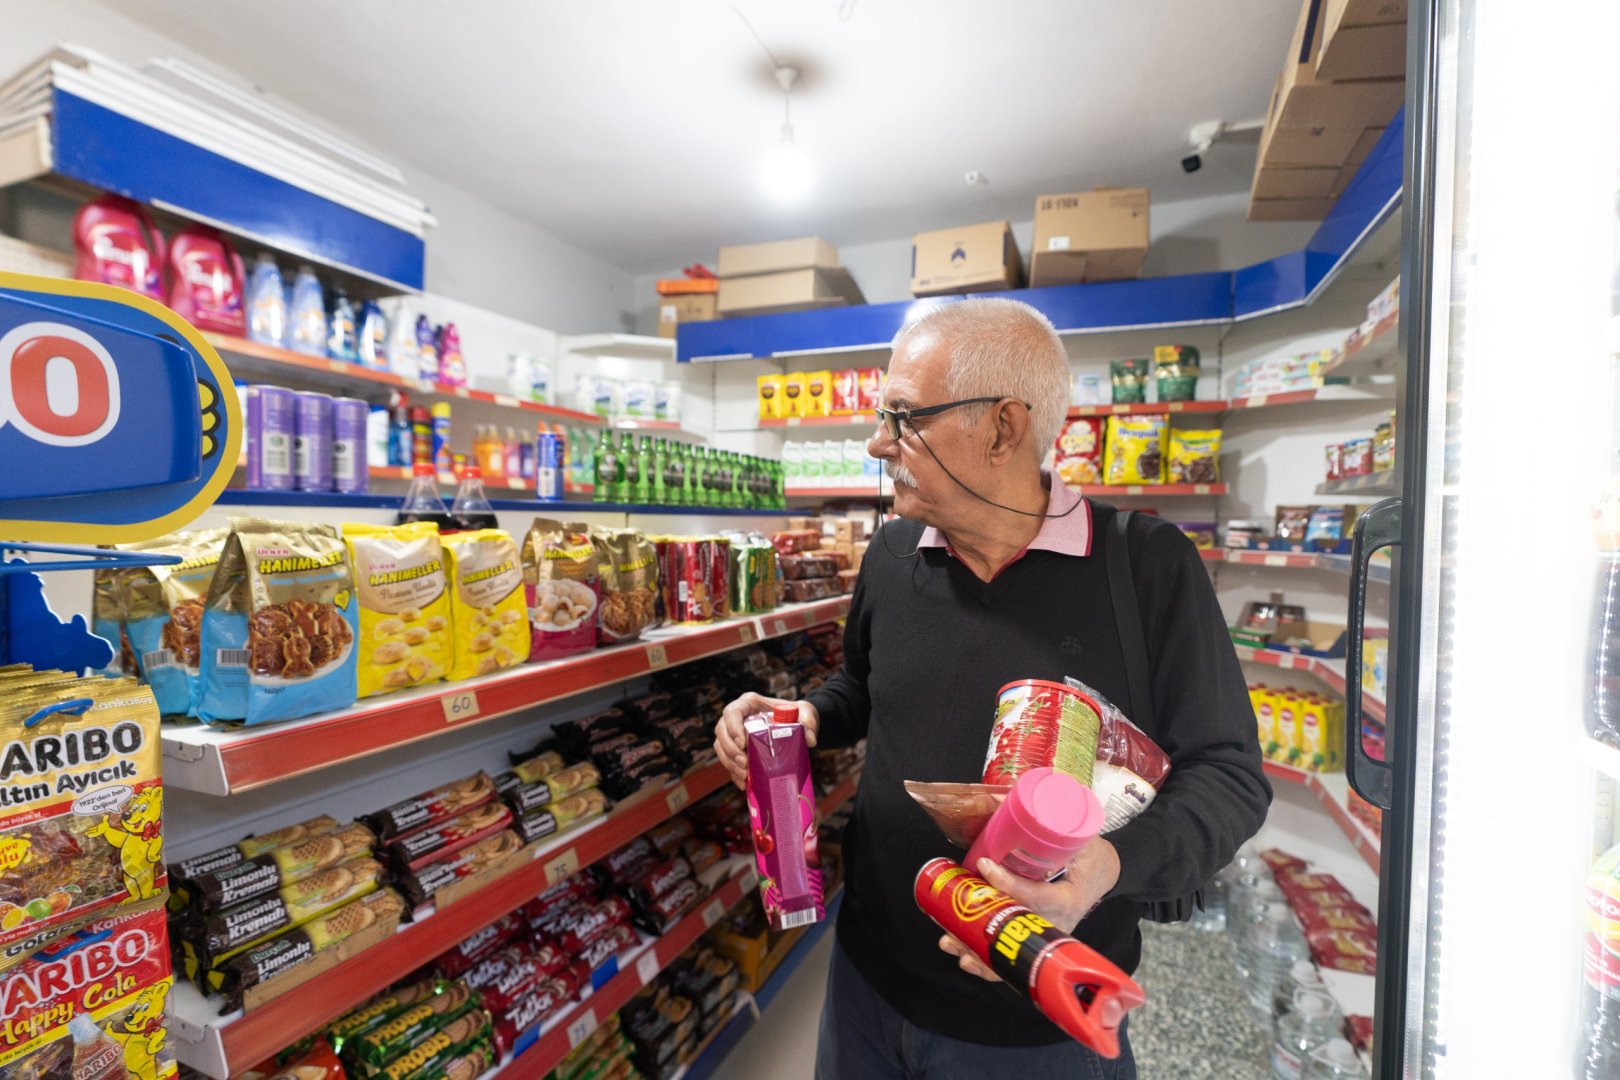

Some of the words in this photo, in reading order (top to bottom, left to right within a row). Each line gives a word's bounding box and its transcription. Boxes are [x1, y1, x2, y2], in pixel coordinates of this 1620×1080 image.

[369, 559, 441, 587] HANIMELLER
[451, 696, 471, 714] 60
[0, 722, 142, 781] ARIBO
[0, 783, 50, 806] ltın
[57, 760, 137, 794] Ayıcık
[111, 787, 126, 798] beri
[92, 798, 118, 812] Orijinal
[221, 864, 277, 891] Limonlu
[222, 874, 279, 904] Kremalı
[226, 898, 282, 928] Limonlu
[229, 907, 286, 939] Kremalı
[994, 912, 1055, 961] etan
[0, 930, 149, 1018] ARIBO
[257, 942, 311, 976] Limonlu
[83, 971, 137, 1009] Cola
[505, 993, 553, 1031] Tutku
